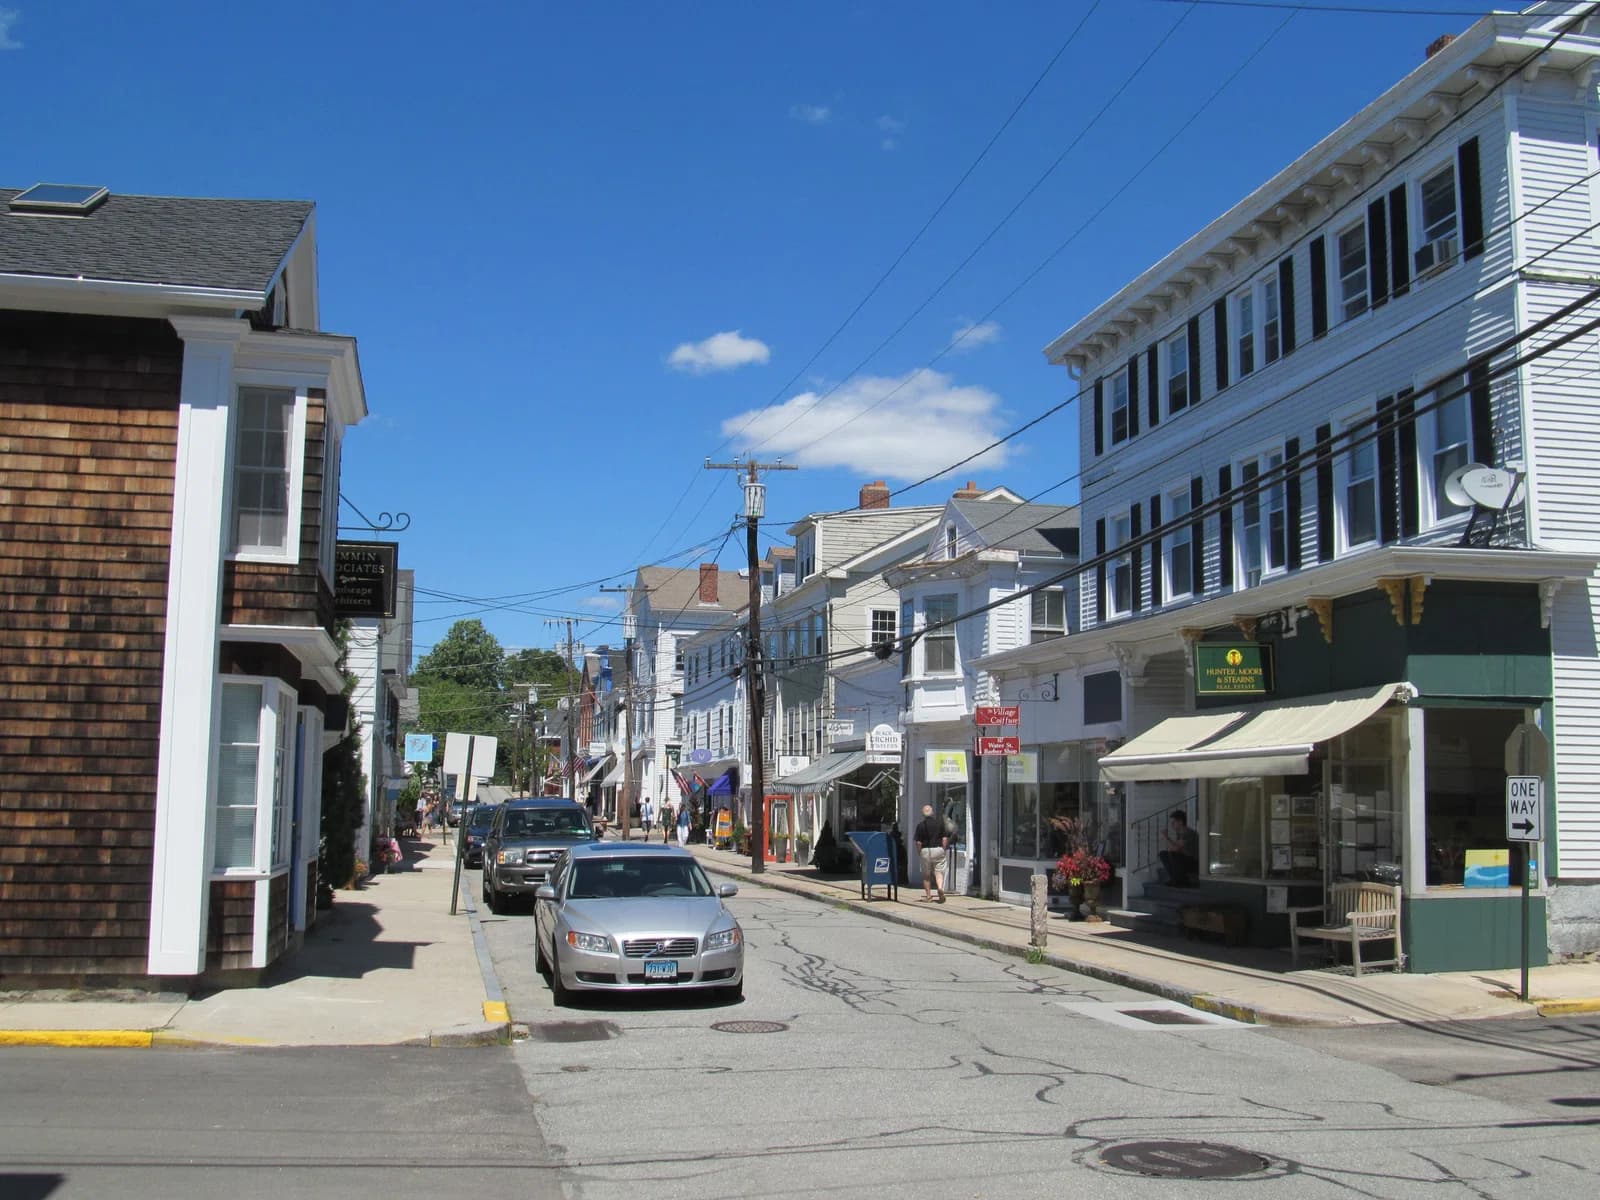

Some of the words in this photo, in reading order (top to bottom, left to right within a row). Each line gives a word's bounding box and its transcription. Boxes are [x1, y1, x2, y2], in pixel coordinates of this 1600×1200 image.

[336, 551, 376, 561] MMIN
[1223, 676, 1255, 684] STEARNS
[993, 706, 1017, 717] Village
[1511, 782, 1536, 797] ONE
[1510, 799, 1536, 815] WAY
